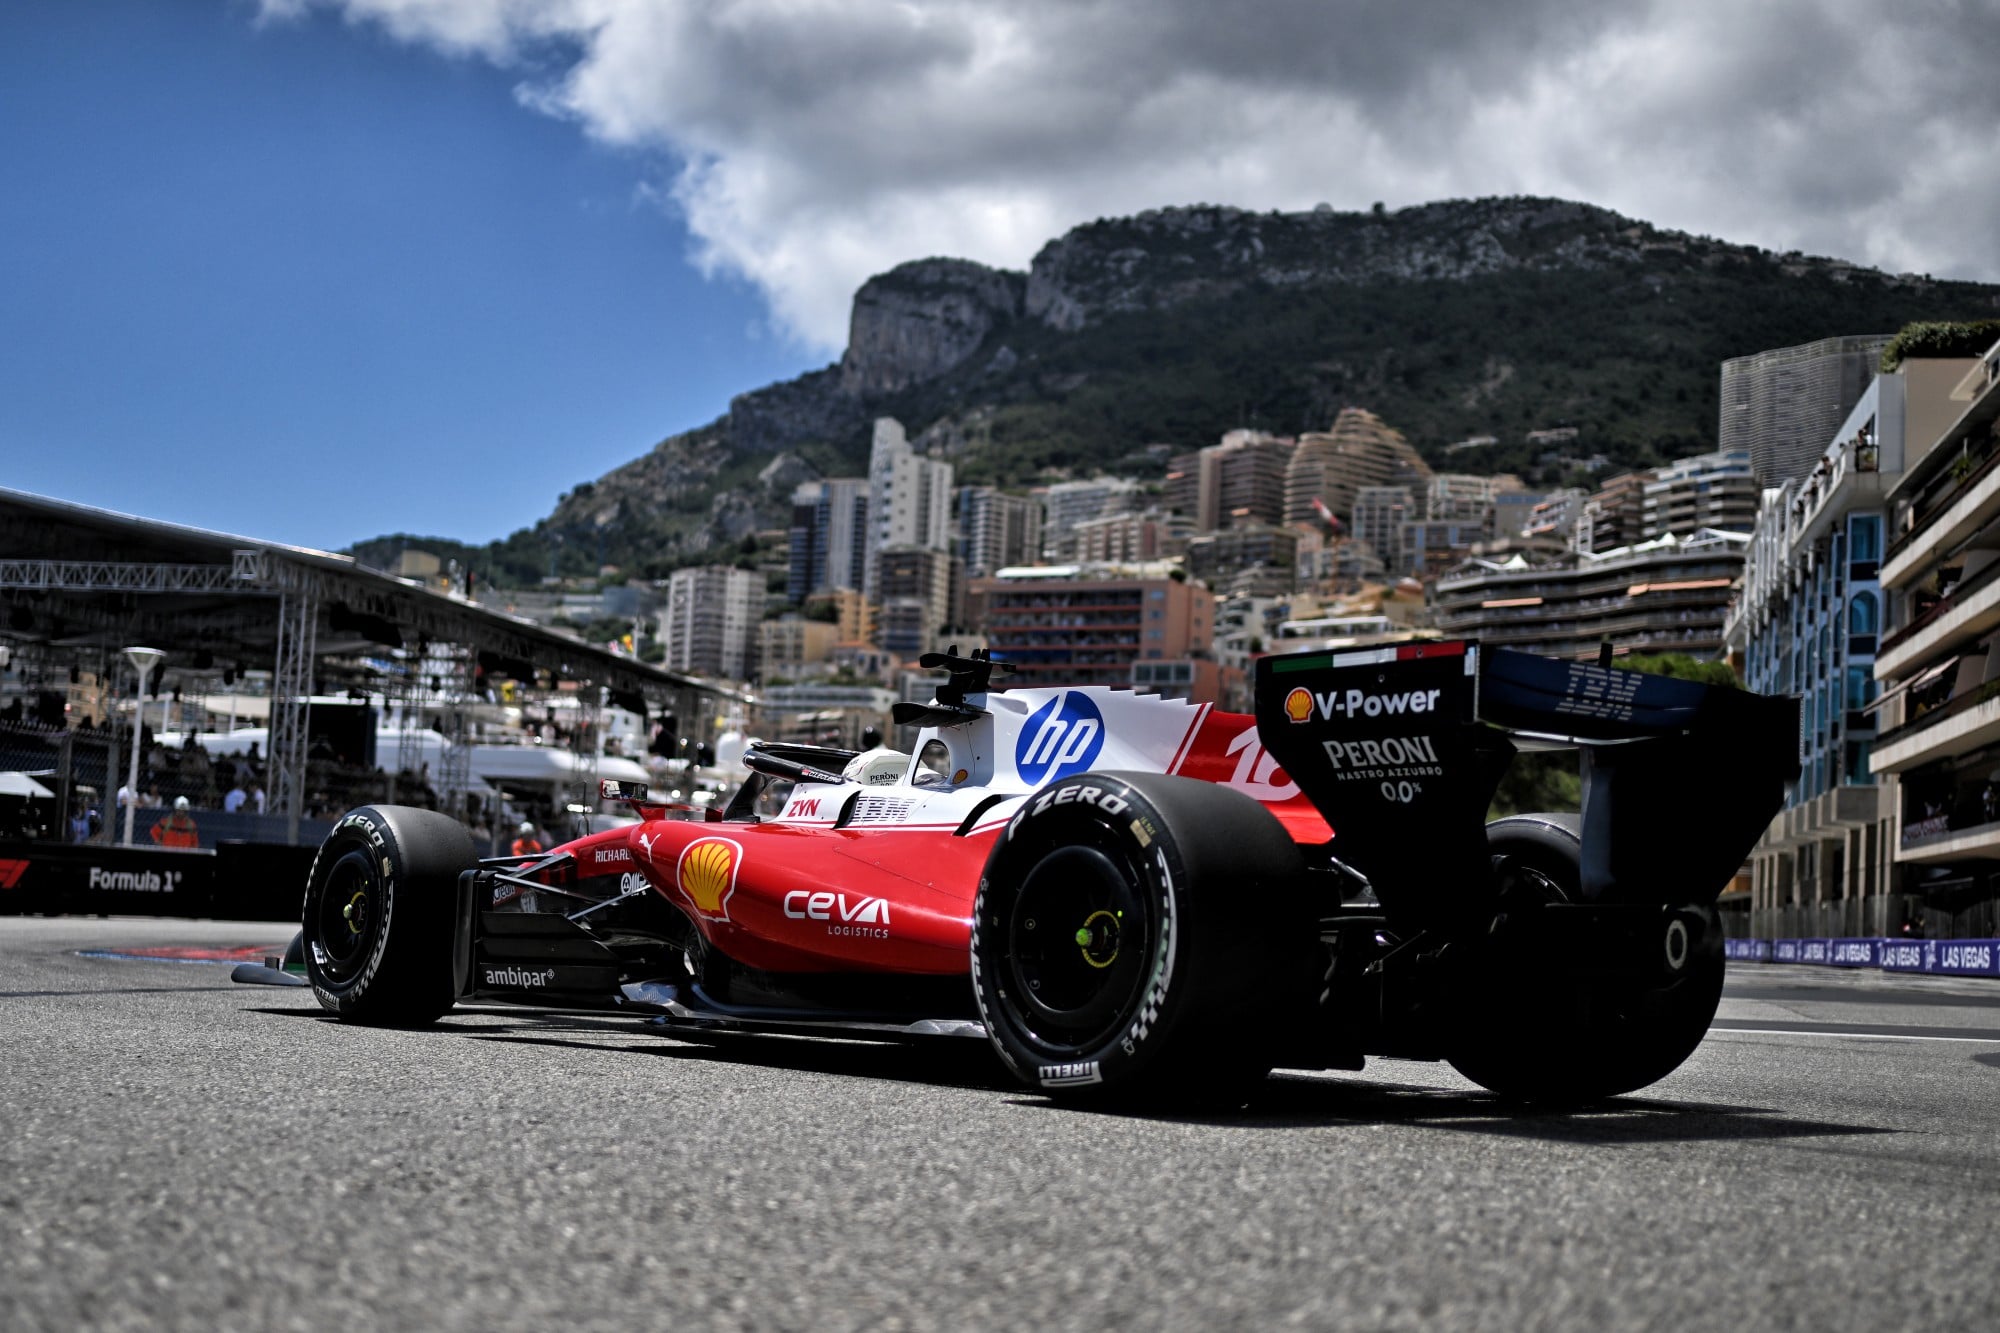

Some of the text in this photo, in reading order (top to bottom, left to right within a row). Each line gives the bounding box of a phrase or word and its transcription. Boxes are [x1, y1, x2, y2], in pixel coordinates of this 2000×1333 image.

[1554, 663, 1643, 721] IBM
[1315, 689, 1440, 720] V-Power
[1021, 692, 1099, 787] hp
[1322, 736, 1438, 768] PERONI
[870, 774, 899, 782] PERONI
[1337, 766, 1443, 780] NASTRO AZZURRO
[787, 799, 821, 817] ZYN
[851, 797, 917, 821] IBM
[1008, 785, 1128, 841] P ZERO
[344, 814, 384, 847] ZERO
[90, 867, 161, 891] Formula
[828, 925, 889, 939] LOGISTICS
[1845, 943, 1871, 962] VEGAS
[1896, 946, 1920, 966] VEGAS
[1942, 946, 1991, 969] LAS VEGAS
[1038, 1060, 1103, 1088] PIRELLI
